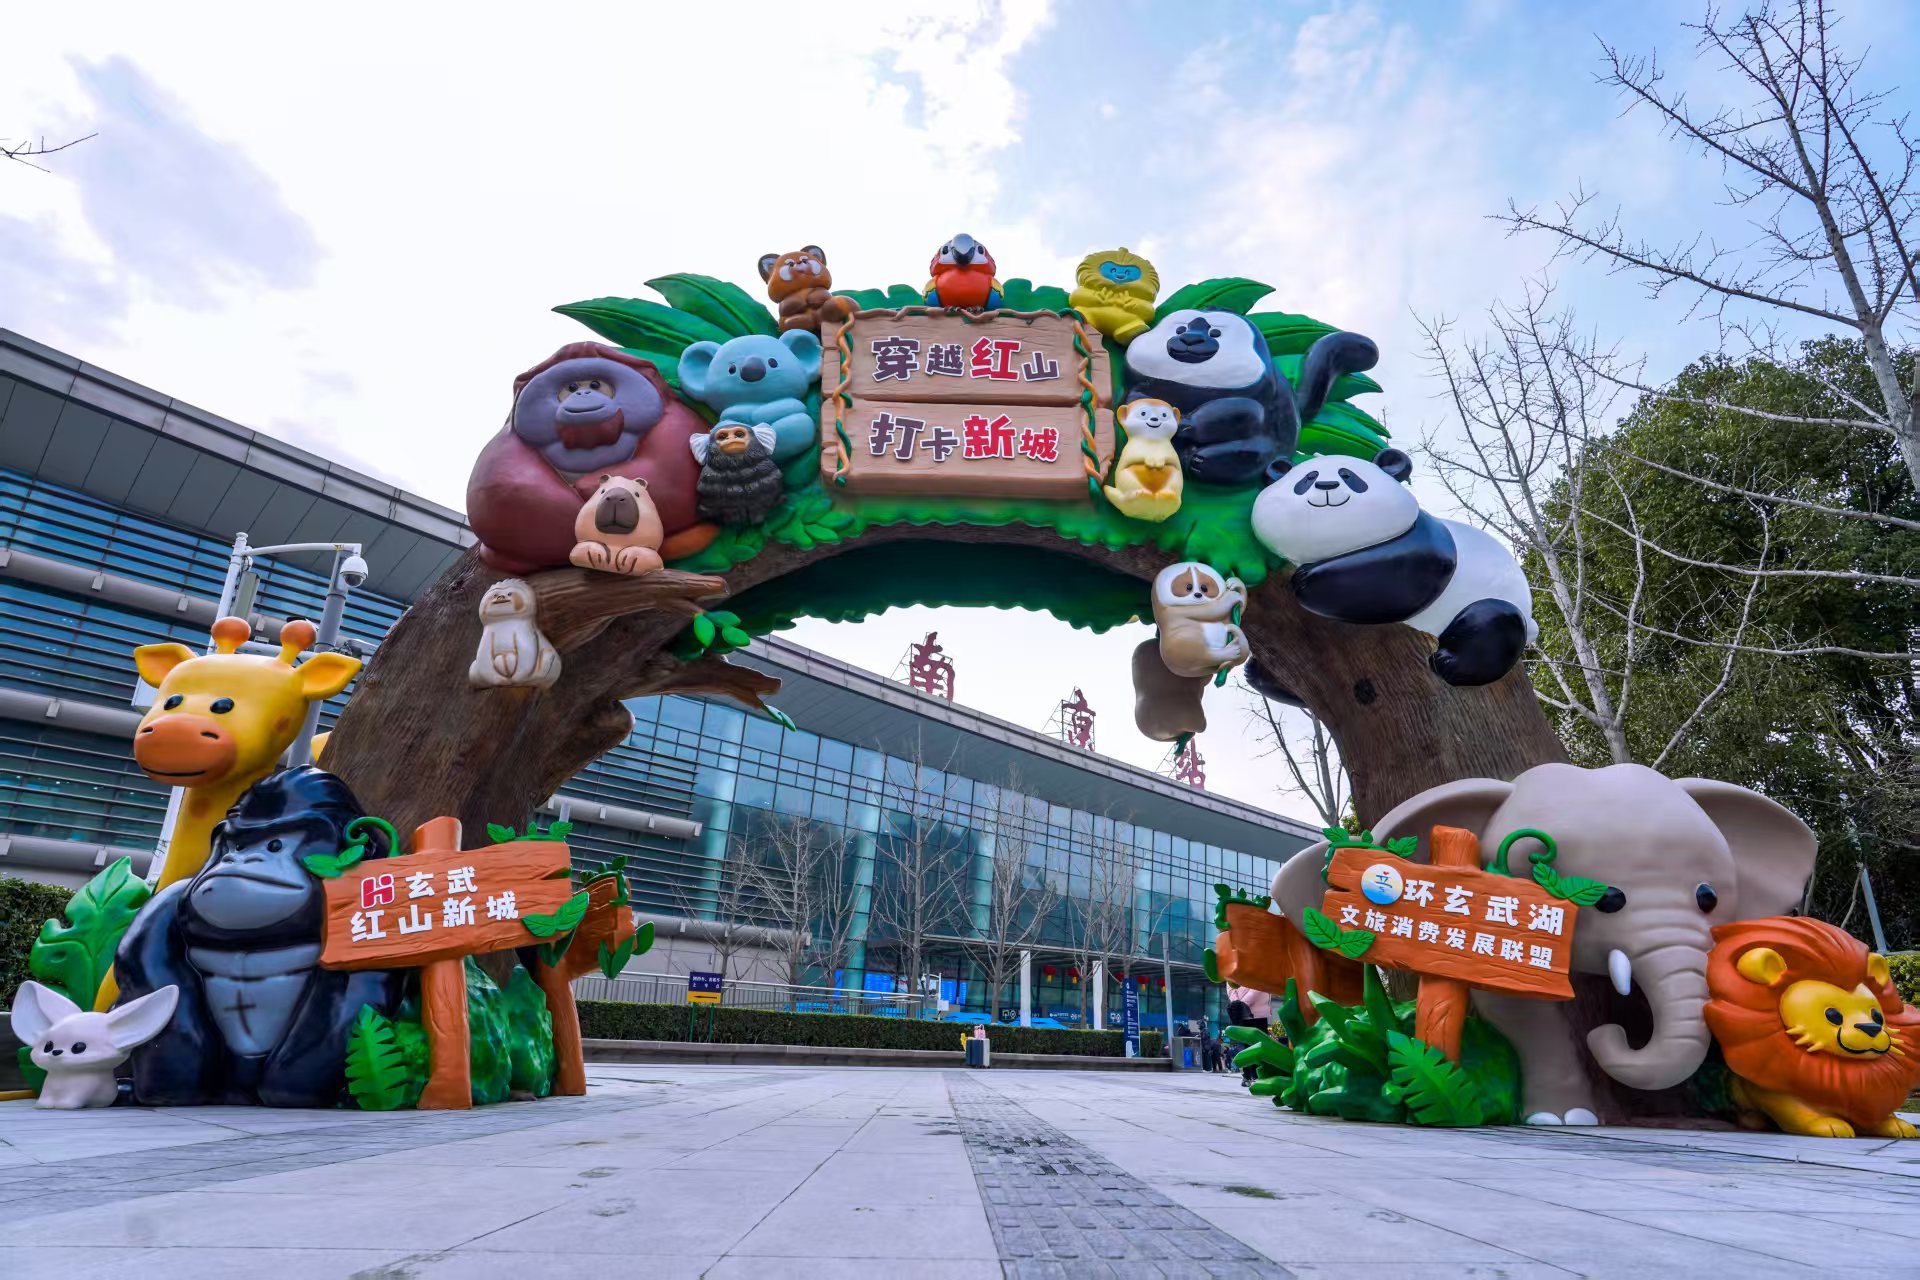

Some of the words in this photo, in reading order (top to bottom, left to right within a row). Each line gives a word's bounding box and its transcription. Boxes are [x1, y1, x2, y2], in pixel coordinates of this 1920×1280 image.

[872, 337, 1060, 382] 穿越红山
[869, 412, 1059, 462] 打卡新城
[405, 866, 477, 898] 玄武
[351, 891, 518, 942] 红山新城
[1404, 879, 1564, 936] 环玄武湖
[1340, 905, 1553, 969] 文旅消费发展联盟
